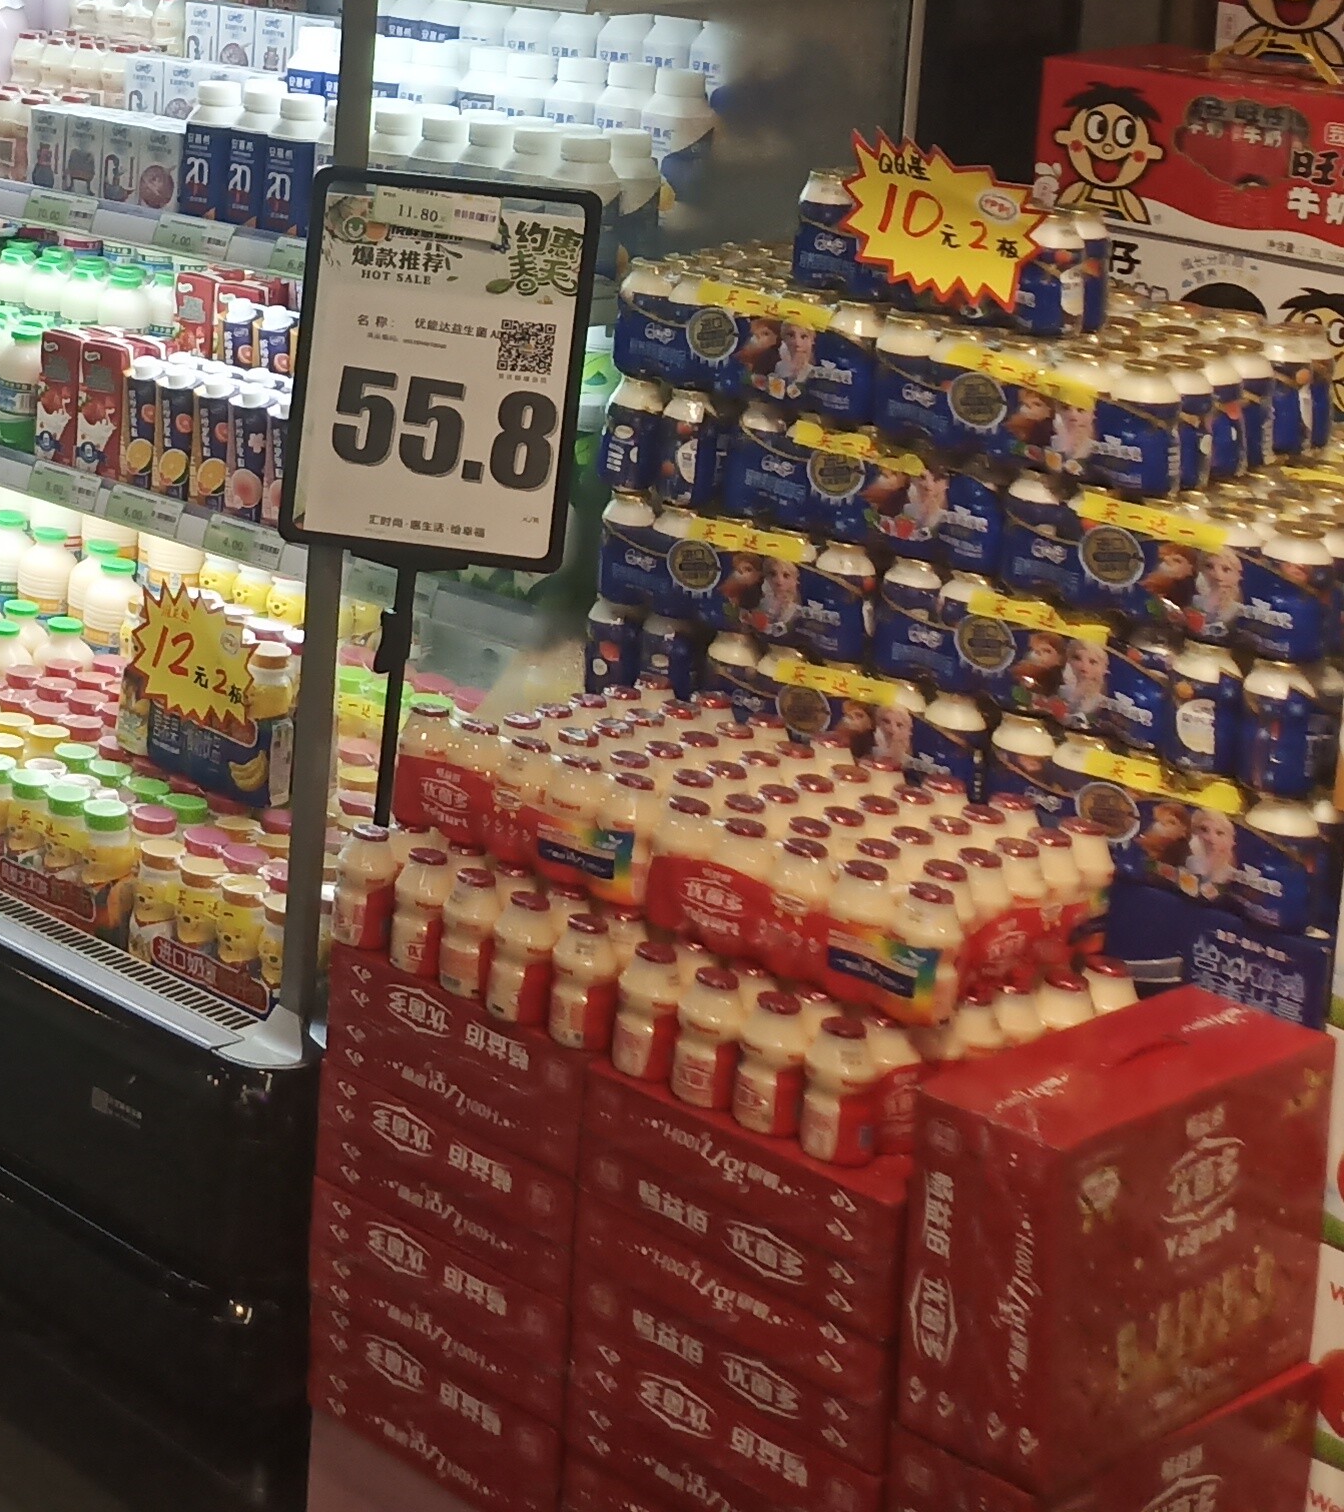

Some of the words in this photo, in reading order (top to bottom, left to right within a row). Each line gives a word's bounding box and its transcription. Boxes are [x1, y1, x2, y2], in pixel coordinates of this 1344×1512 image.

[184, 156, 210, 186] 20
[227, 162, 253, 193] 20
[1289, 150, 1344, 187] 旺
[265, 171, 292, 202] 20
[398, 203, 439, 223] 11.80
[351, 244, 445, 274] 爆款推荐
[361, 270, 390, 282] HOT
[396, 273, 432, 286] SALE
[331, 365, 559, 492] 55.8
